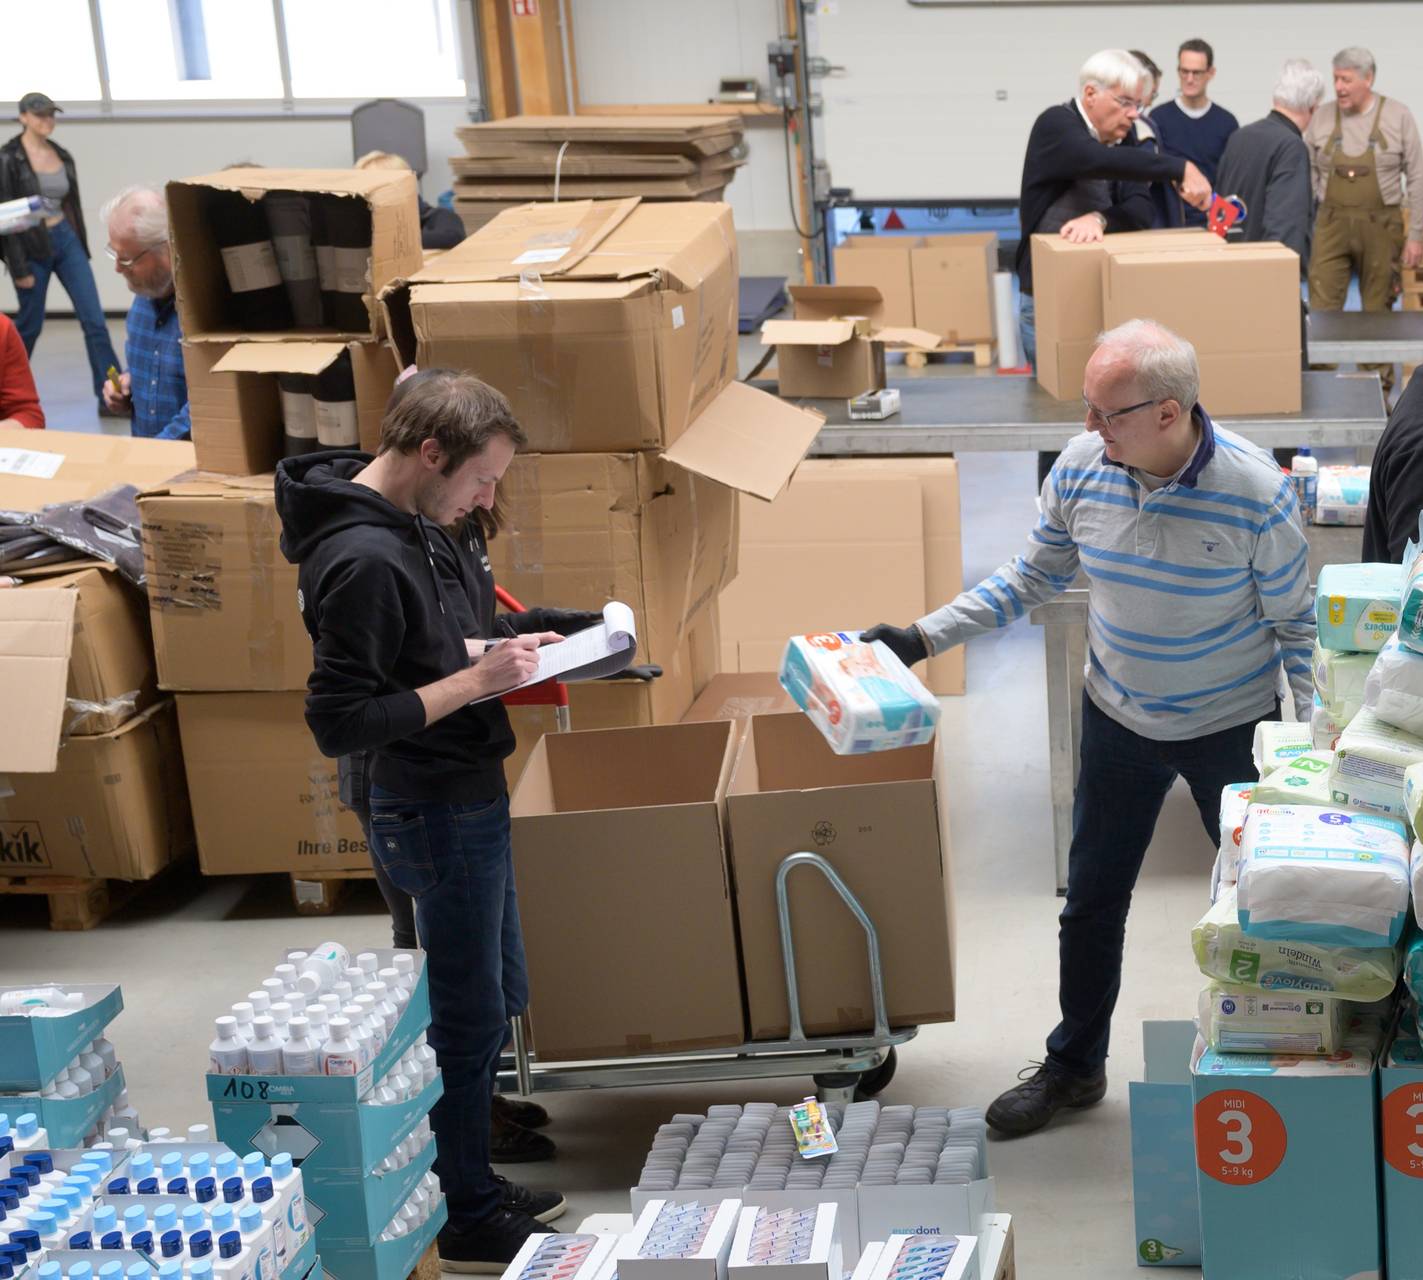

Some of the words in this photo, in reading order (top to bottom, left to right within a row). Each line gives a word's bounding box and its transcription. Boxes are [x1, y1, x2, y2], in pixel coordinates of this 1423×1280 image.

[297, 839, 332, 856] Ihre
[1278, 946, 1322, 969] Windeln
[1235, 959, 1253, 979] 2
[223, 1077, 270, 1100] 108
[1224, 1099, 1245, 1109] MIDI
[1216, 1109, 1253, 1165] 3
[1222, 1166, 1239, 1176] 5-9
[1242, 1166, 1254, 1178] kg
[1147, 1241, 1157, 1253] 3
